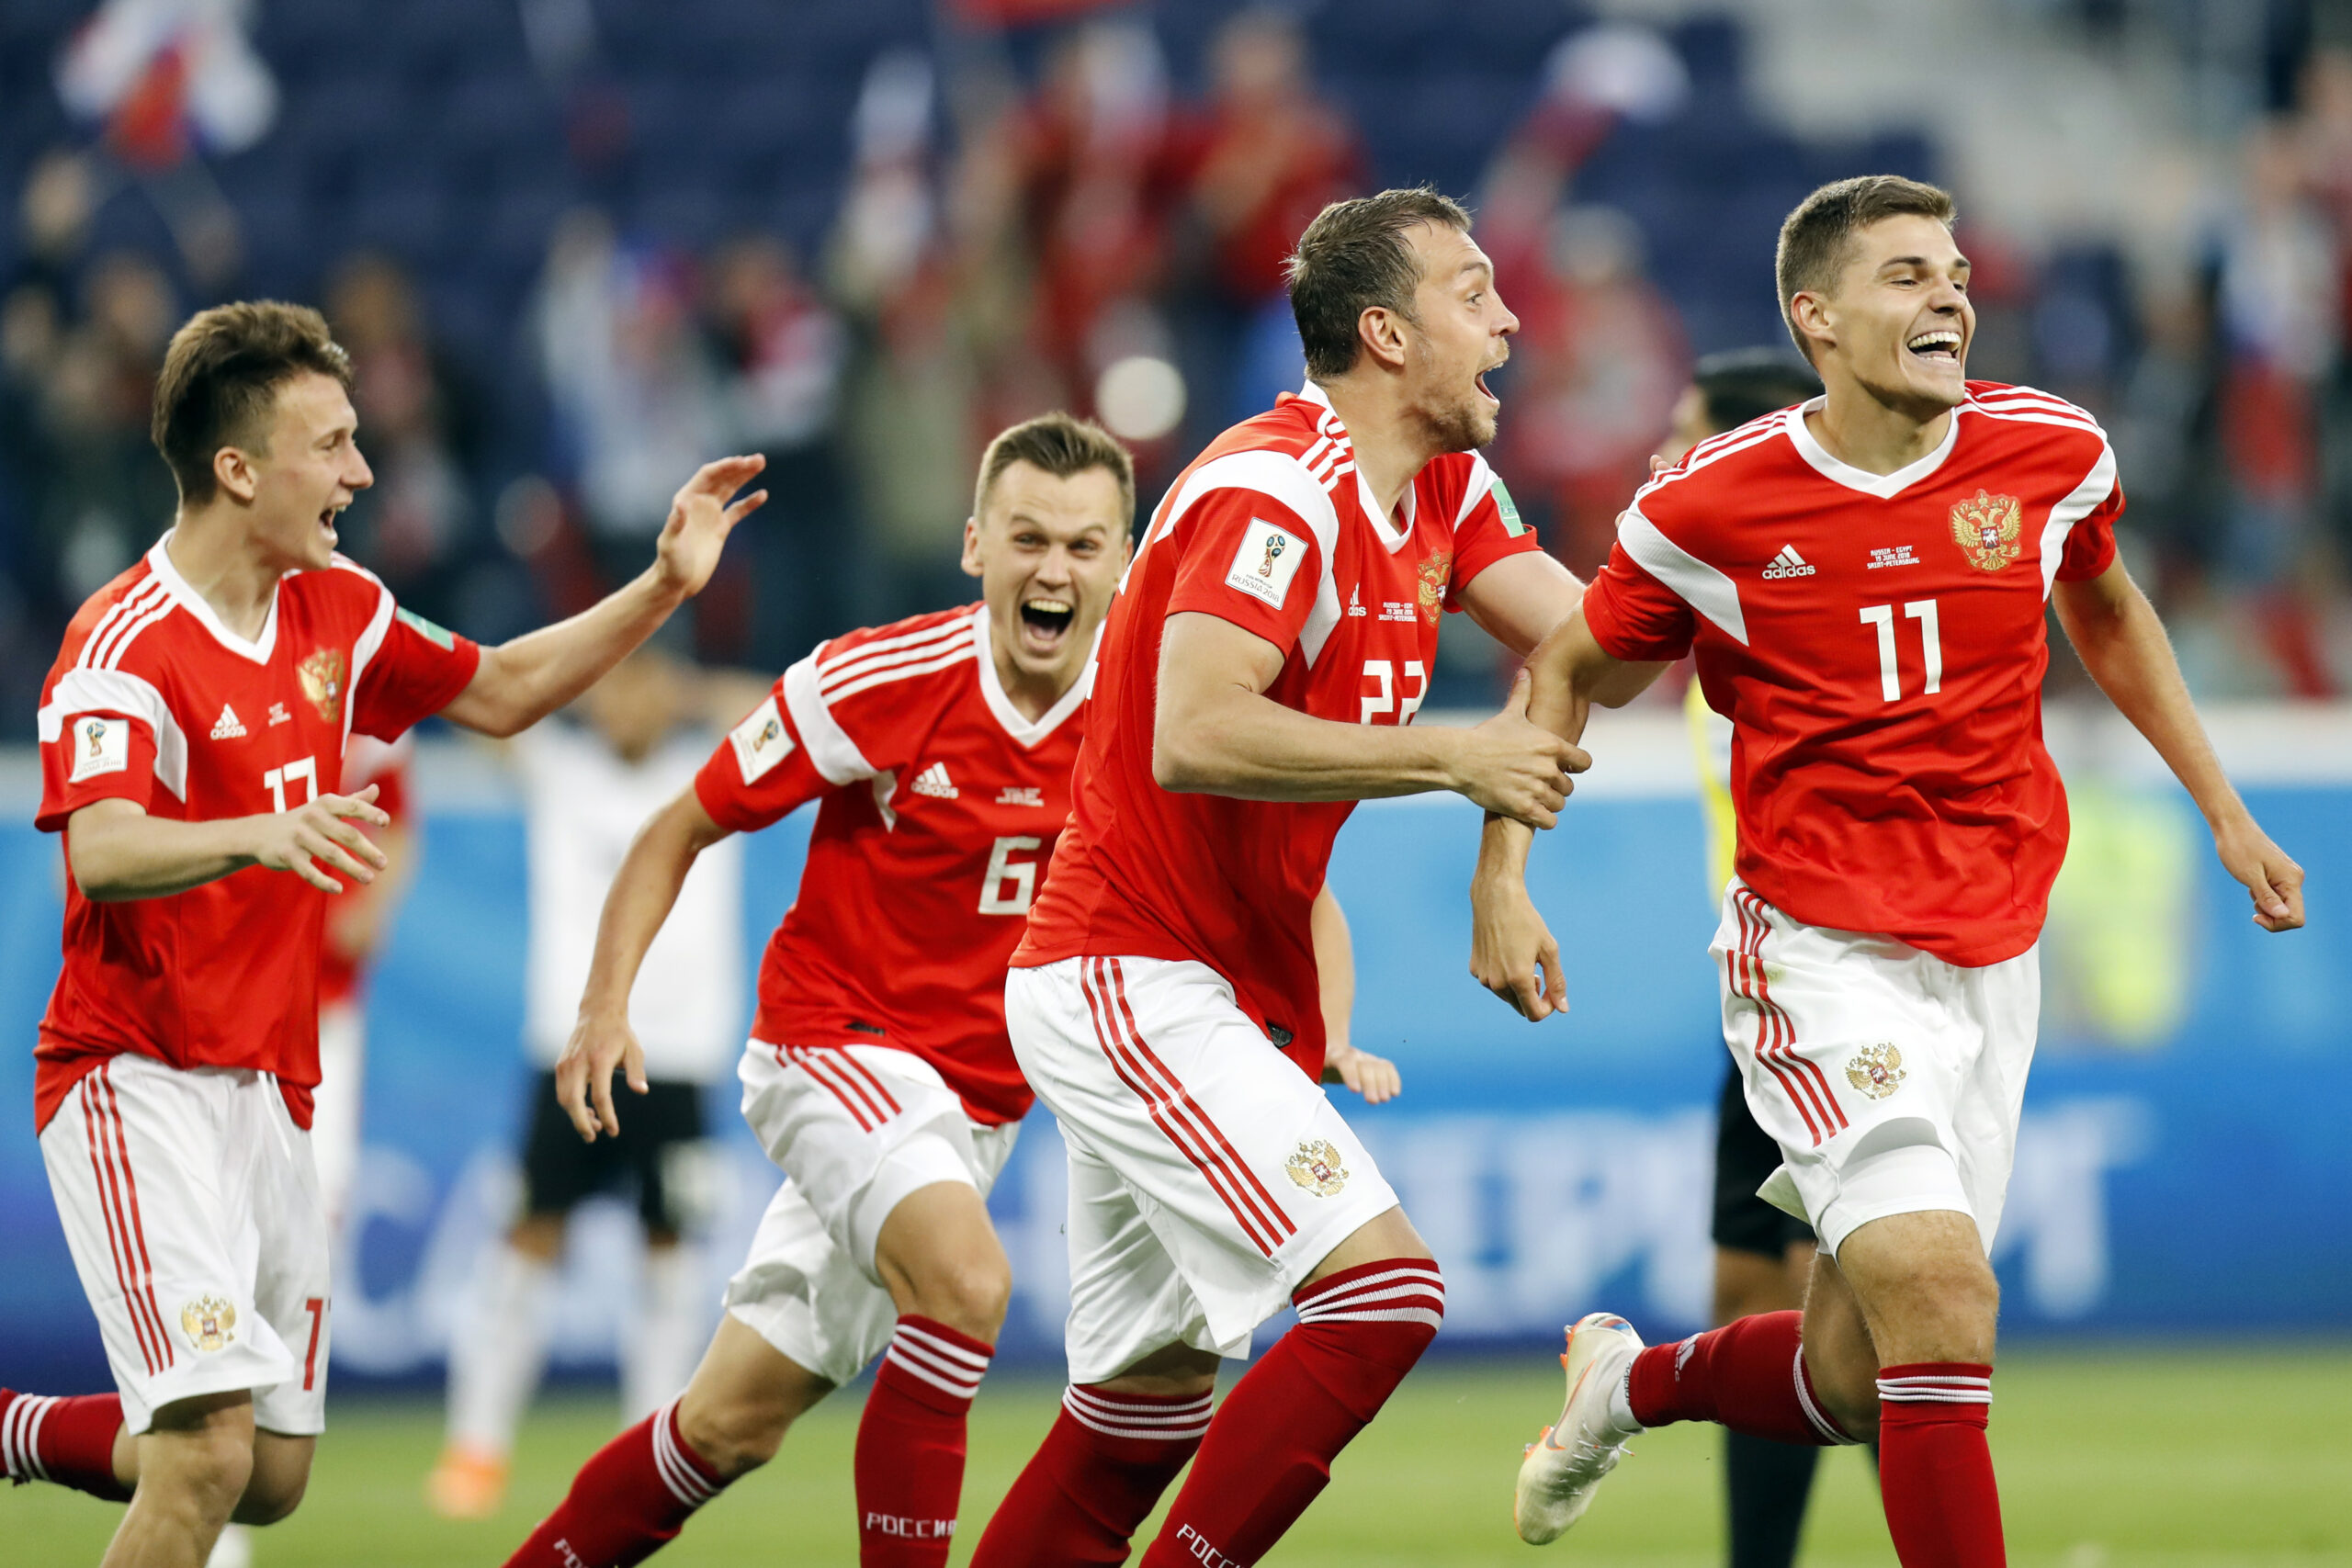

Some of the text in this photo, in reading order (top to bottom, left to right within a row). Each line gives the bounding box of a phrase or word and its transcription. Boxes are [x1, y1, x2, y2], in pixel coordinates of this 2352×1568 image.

[1883, 553, 1896, 561] JUNE
[1896, 545, 1913, 554] EGYPT
[1761, 565, 1816, 580] adidas
[1231, 574, 1280, 603] RUSSIA 2018
[1859, 598, 1942, 703] 11
[1361, 660, 1428, 726] 22
[210, 725, 247, 741] adidas
[264, 755, 318, 815] 17
[910, 781, 959, 799] adidas
[978, 836, 1042, 915] 6
[303, 1297, 330, 1392] 1
